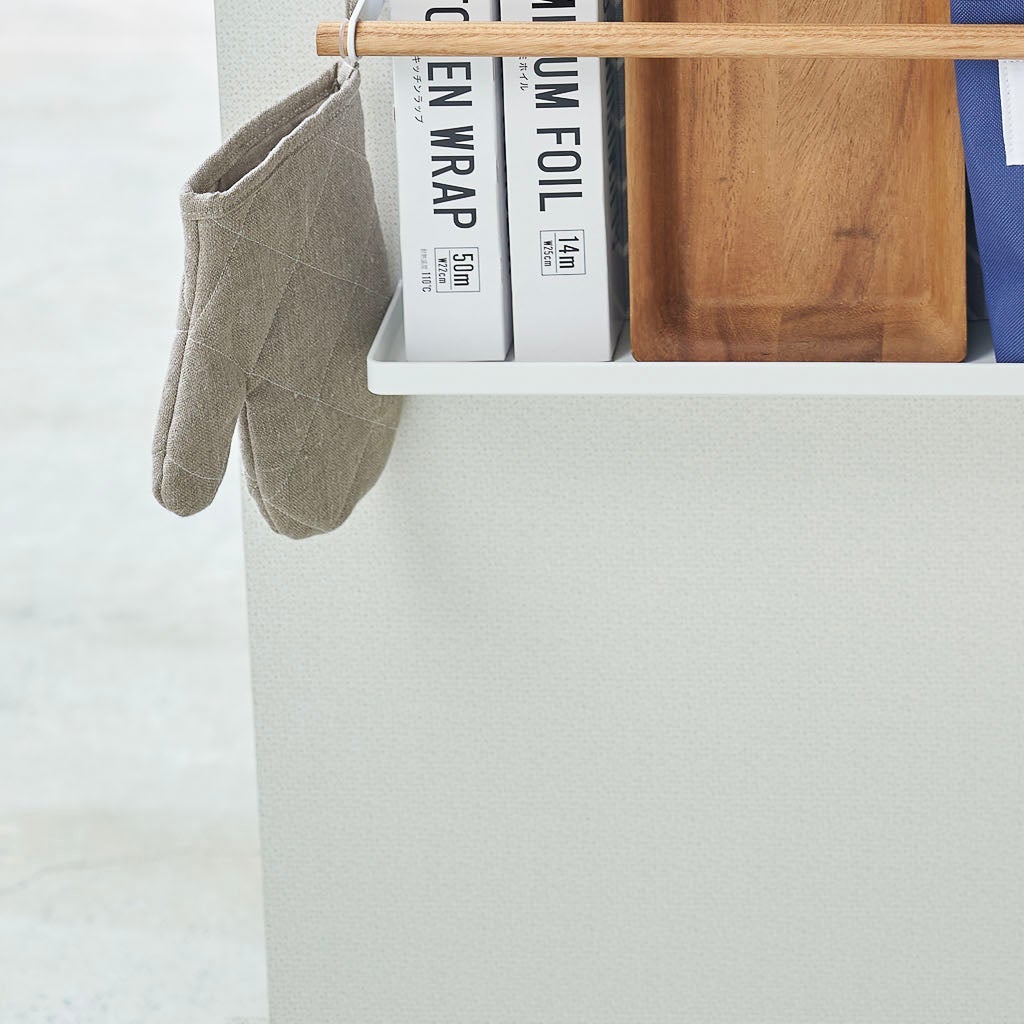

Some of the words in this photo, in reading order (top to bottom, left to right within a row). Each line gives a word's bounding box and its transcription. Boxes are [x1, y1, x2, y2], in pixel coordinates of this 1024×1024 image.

[519, 57, 529, 91] ミホイル
[430, 125, 478, 229] WRAP
[536, 126, 583, 212] FOIL
[543, 240, 554, 267] W25cm
[558, 235, 580, 269] 14m
[437, 257, 448, 284] W22cm
[452, 253, 474, 287] 50m
